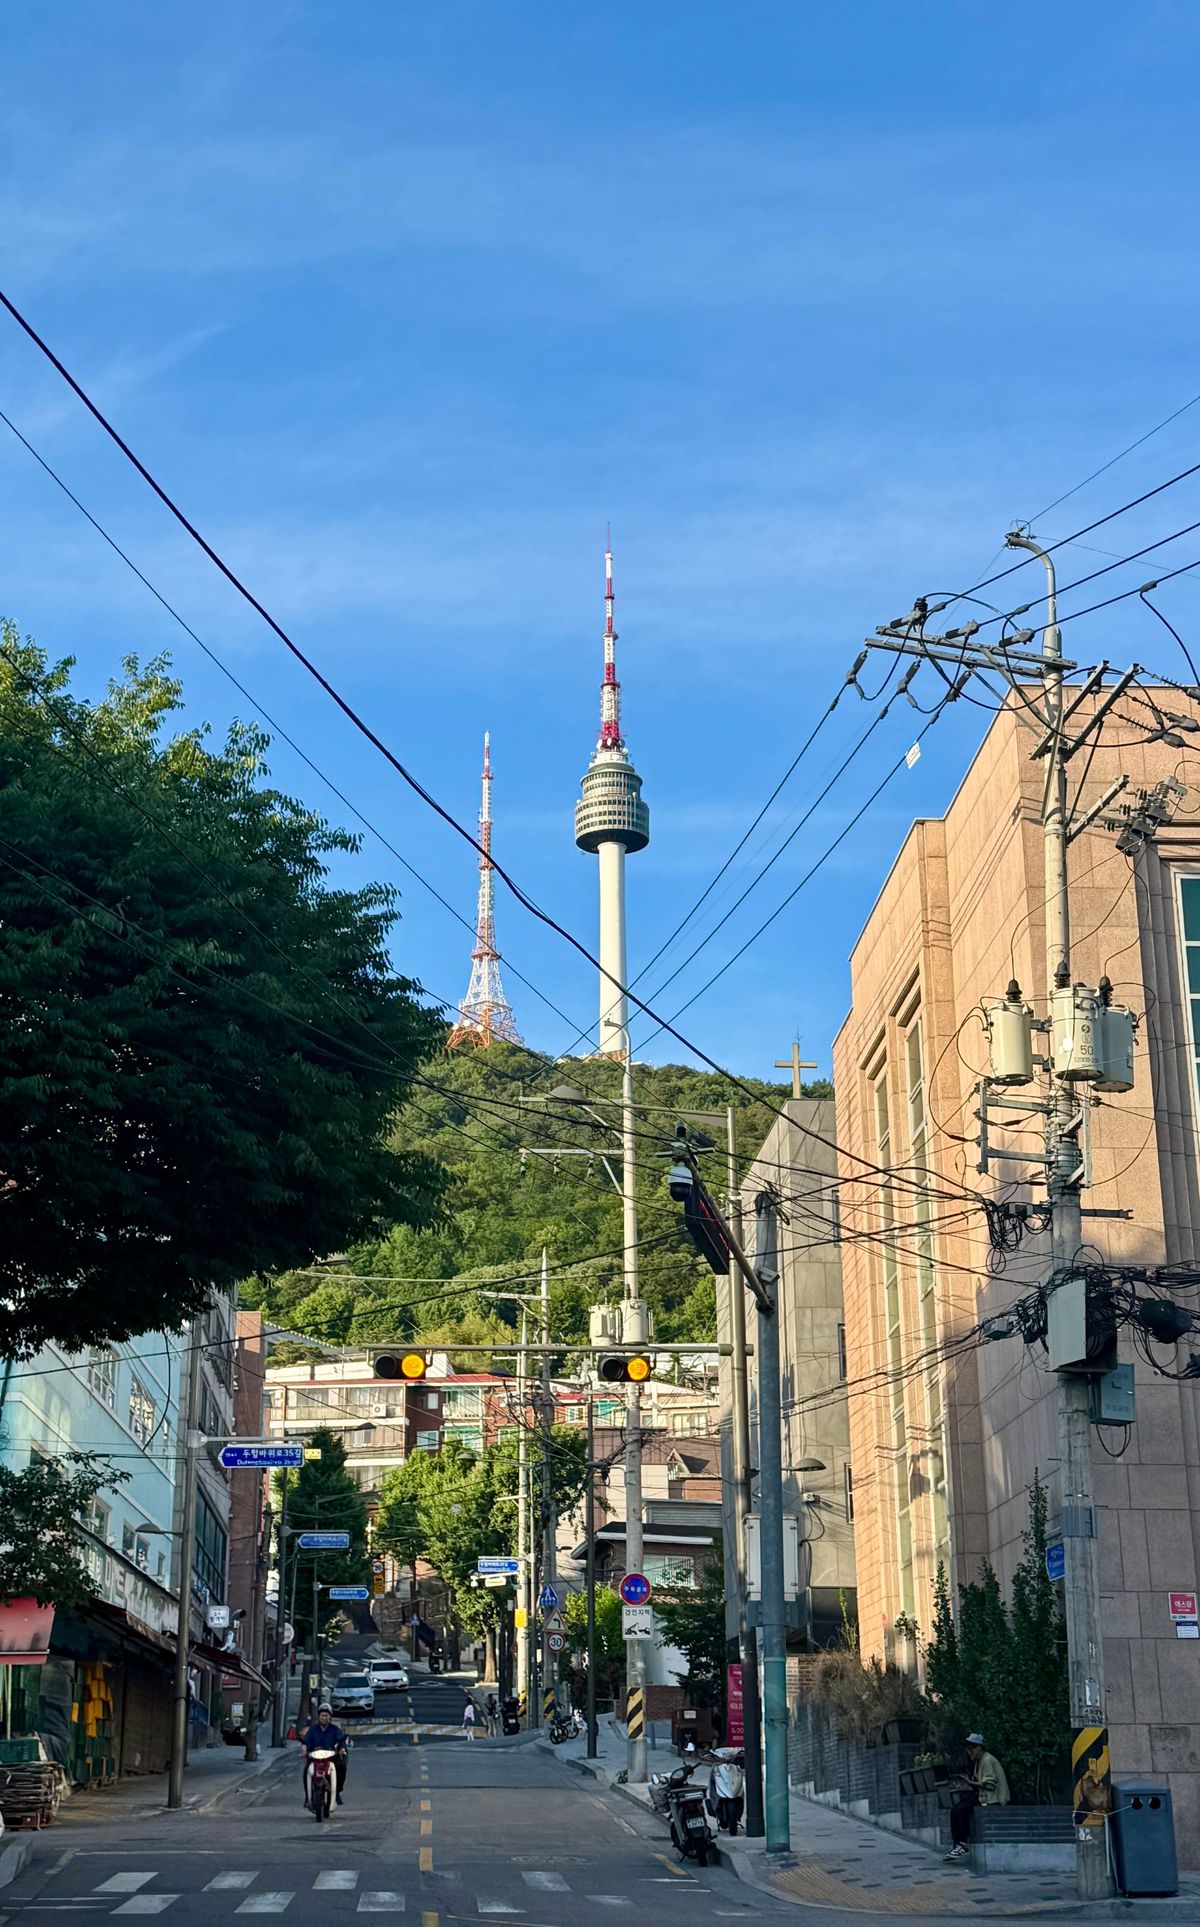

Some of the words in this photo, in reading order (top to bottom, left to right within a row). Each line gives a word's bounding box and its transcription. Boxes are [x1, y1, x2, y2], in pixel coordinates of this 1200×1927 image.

[1080, 1045, 1094, 1056] 50
[243, 1448, 302, 1459] 두텁바위로35길
[624, 1608, 650, 1616] 견인지역
[550, 1637, 562, 1648] 30
